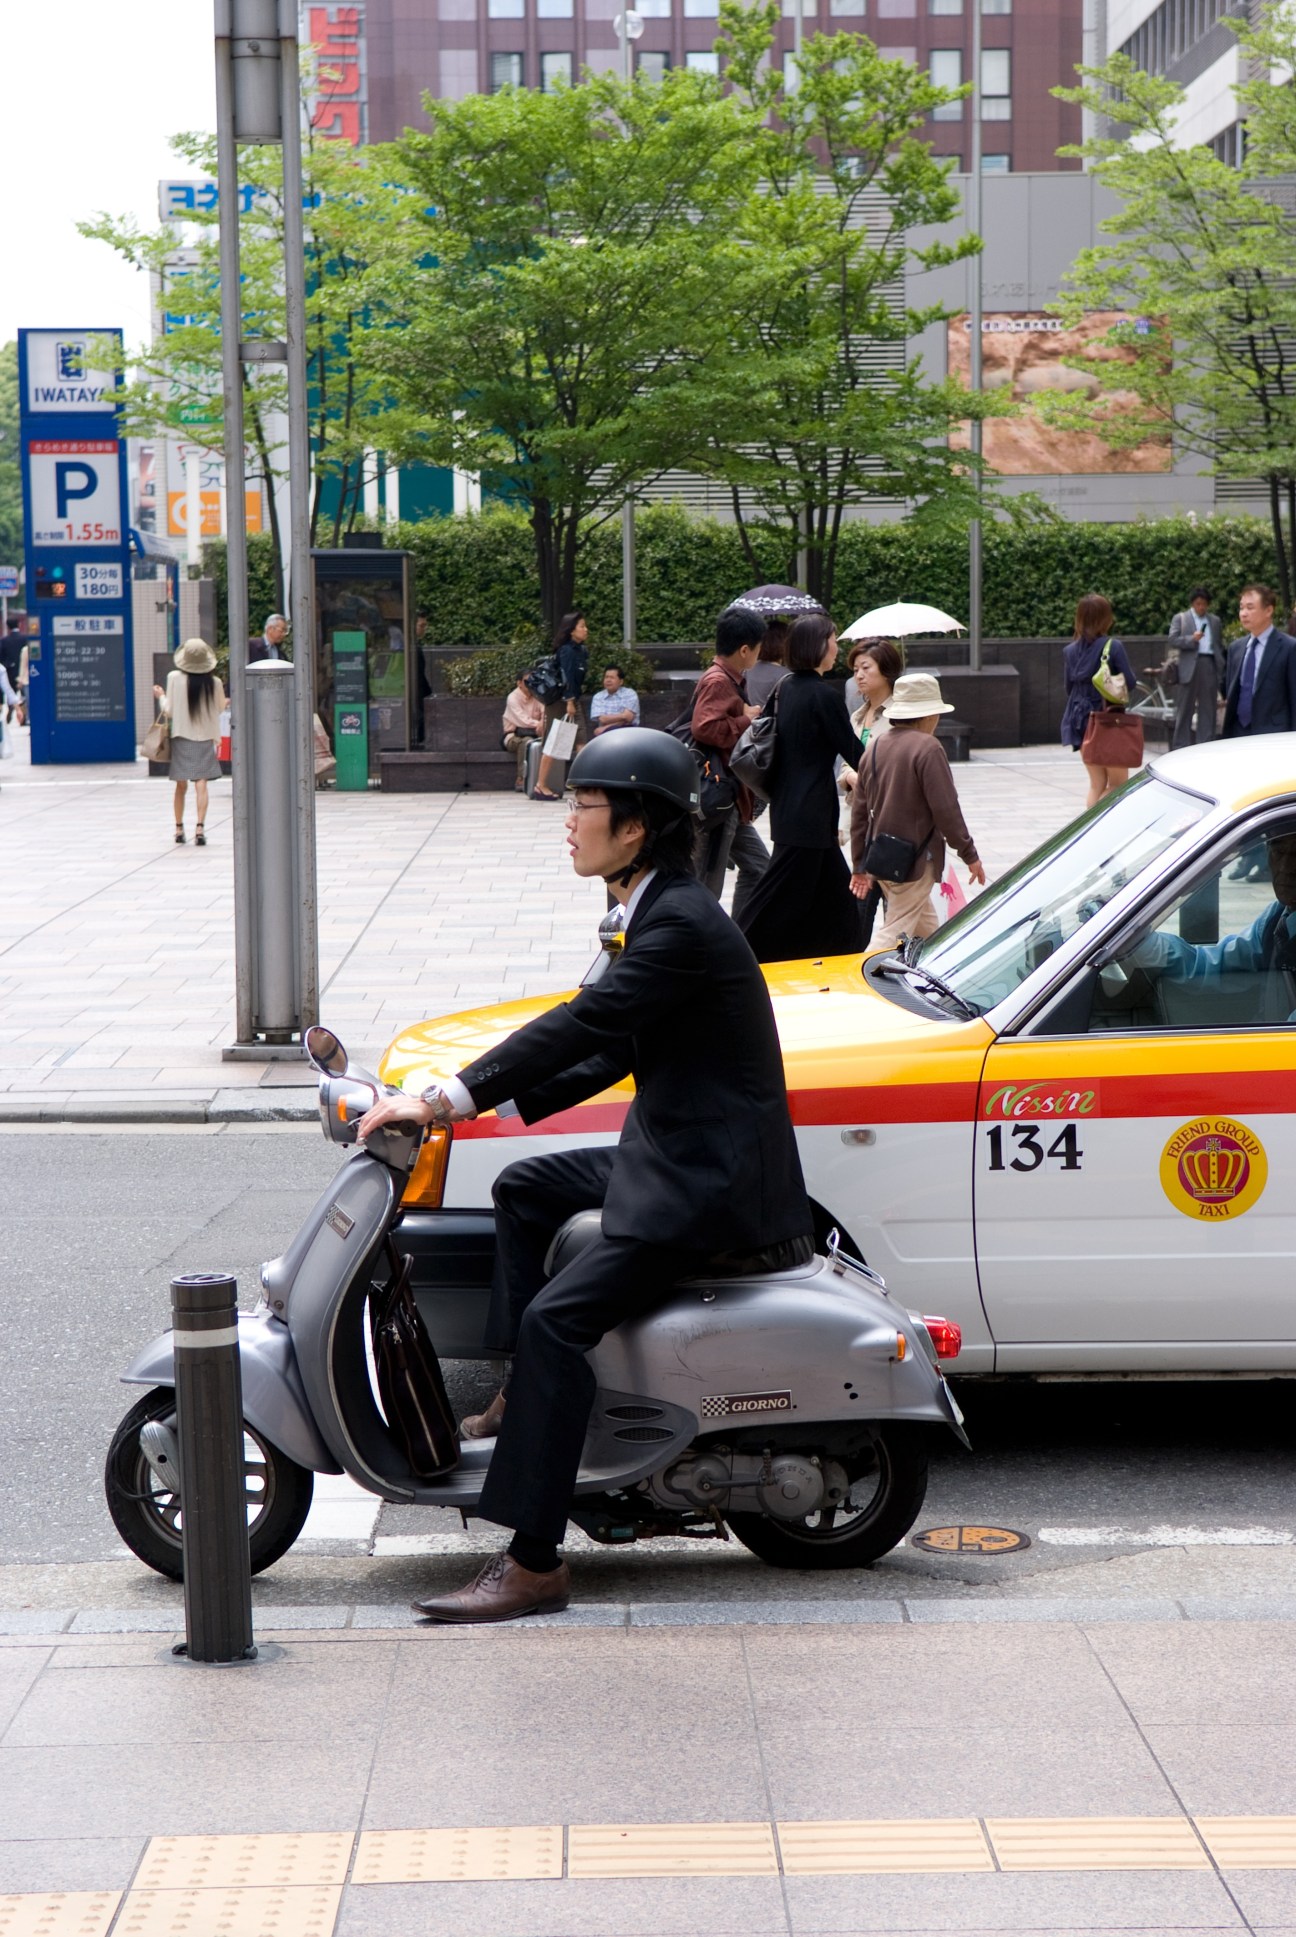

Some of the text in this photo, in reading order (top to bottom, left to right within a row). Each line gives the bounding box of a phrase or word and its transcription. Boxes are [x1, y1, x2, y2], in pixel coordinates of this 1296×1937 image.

[55, 461, 98, 518] P
[65, 523, 118, 541] 1.55m
[82, 583, 119, 595] 180円
[985, 1081, 1097, 1117] Nissin
[986, 1123, 1083, 1172] 134
[1166, 1120, 1260, 1160] FRIEND GROUP
[1198, 1203, 1230, 1217] TAXI
[731, 1397, 788, 1412] GIORNO
